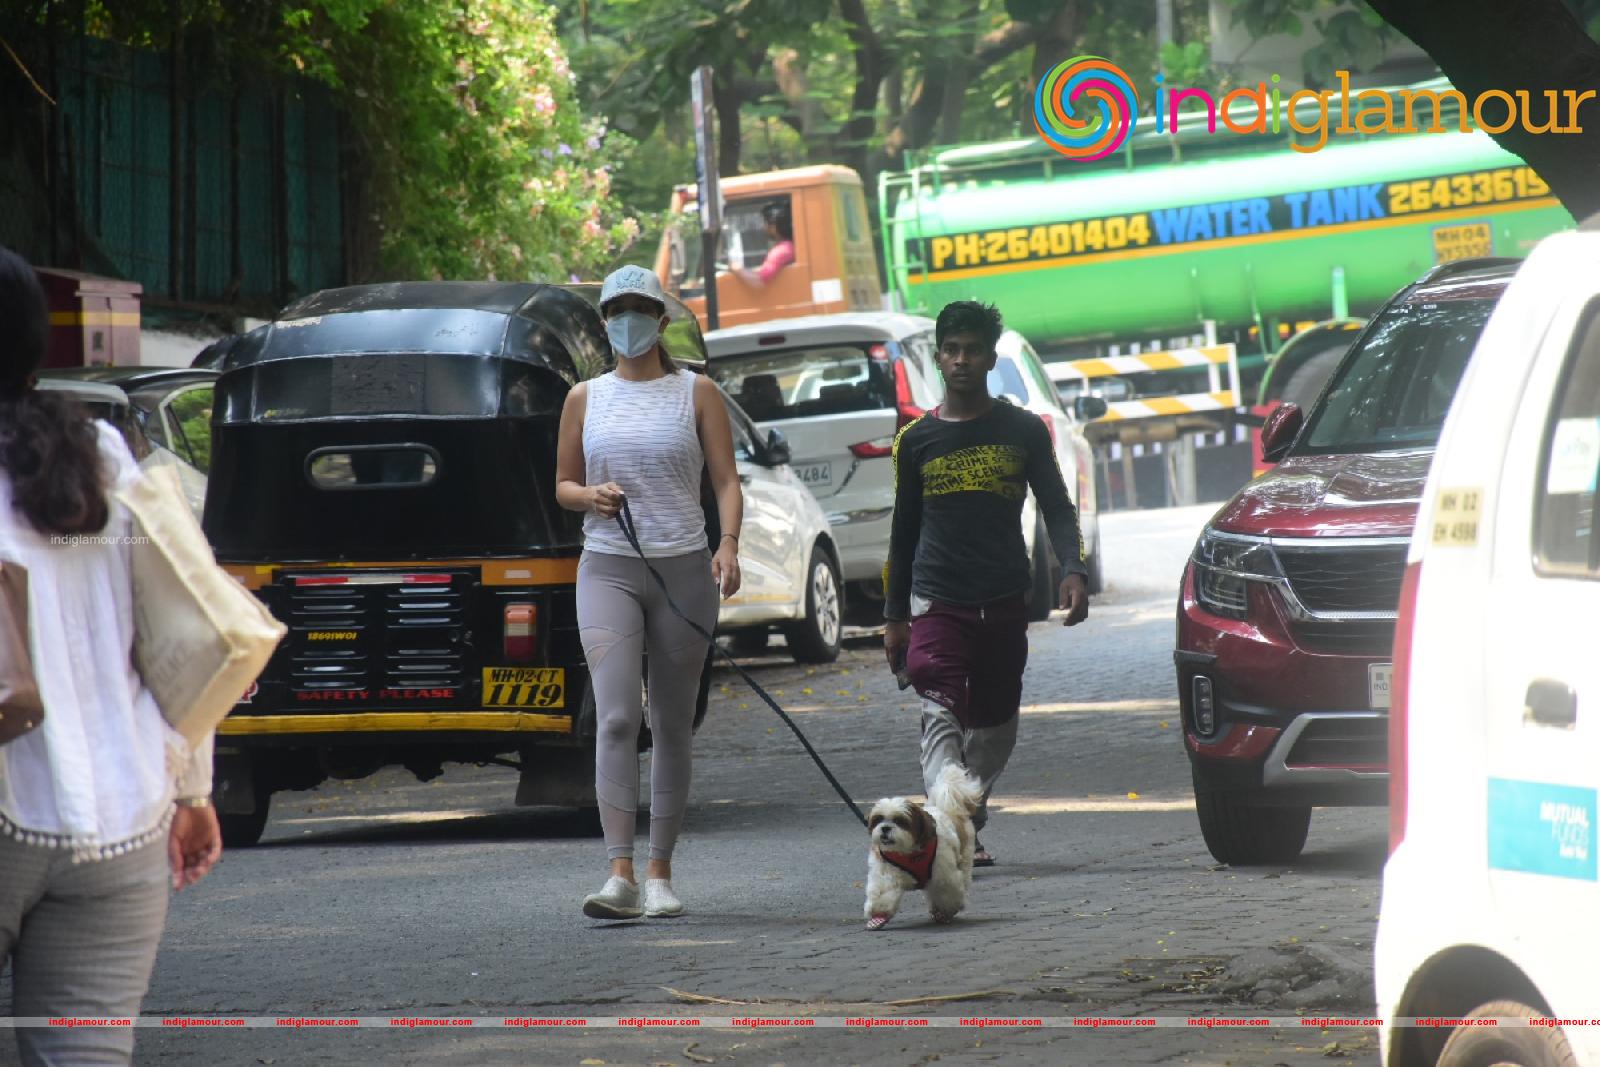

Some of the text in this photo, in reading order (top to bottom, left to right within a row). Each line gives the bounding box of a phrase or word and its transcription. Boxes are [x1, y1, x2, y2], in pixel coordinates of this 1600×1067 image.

[931, 214, 1150, 269] PH:26401404
[1152, 198, 1272, 244] WATER
[1284, 183, 1386, 229] TANK
[946, 456, 989, 471] CRIME
[296, 688, 455, 700] SAFETY PLEASE
[486, 684, 562, 706] 1119
